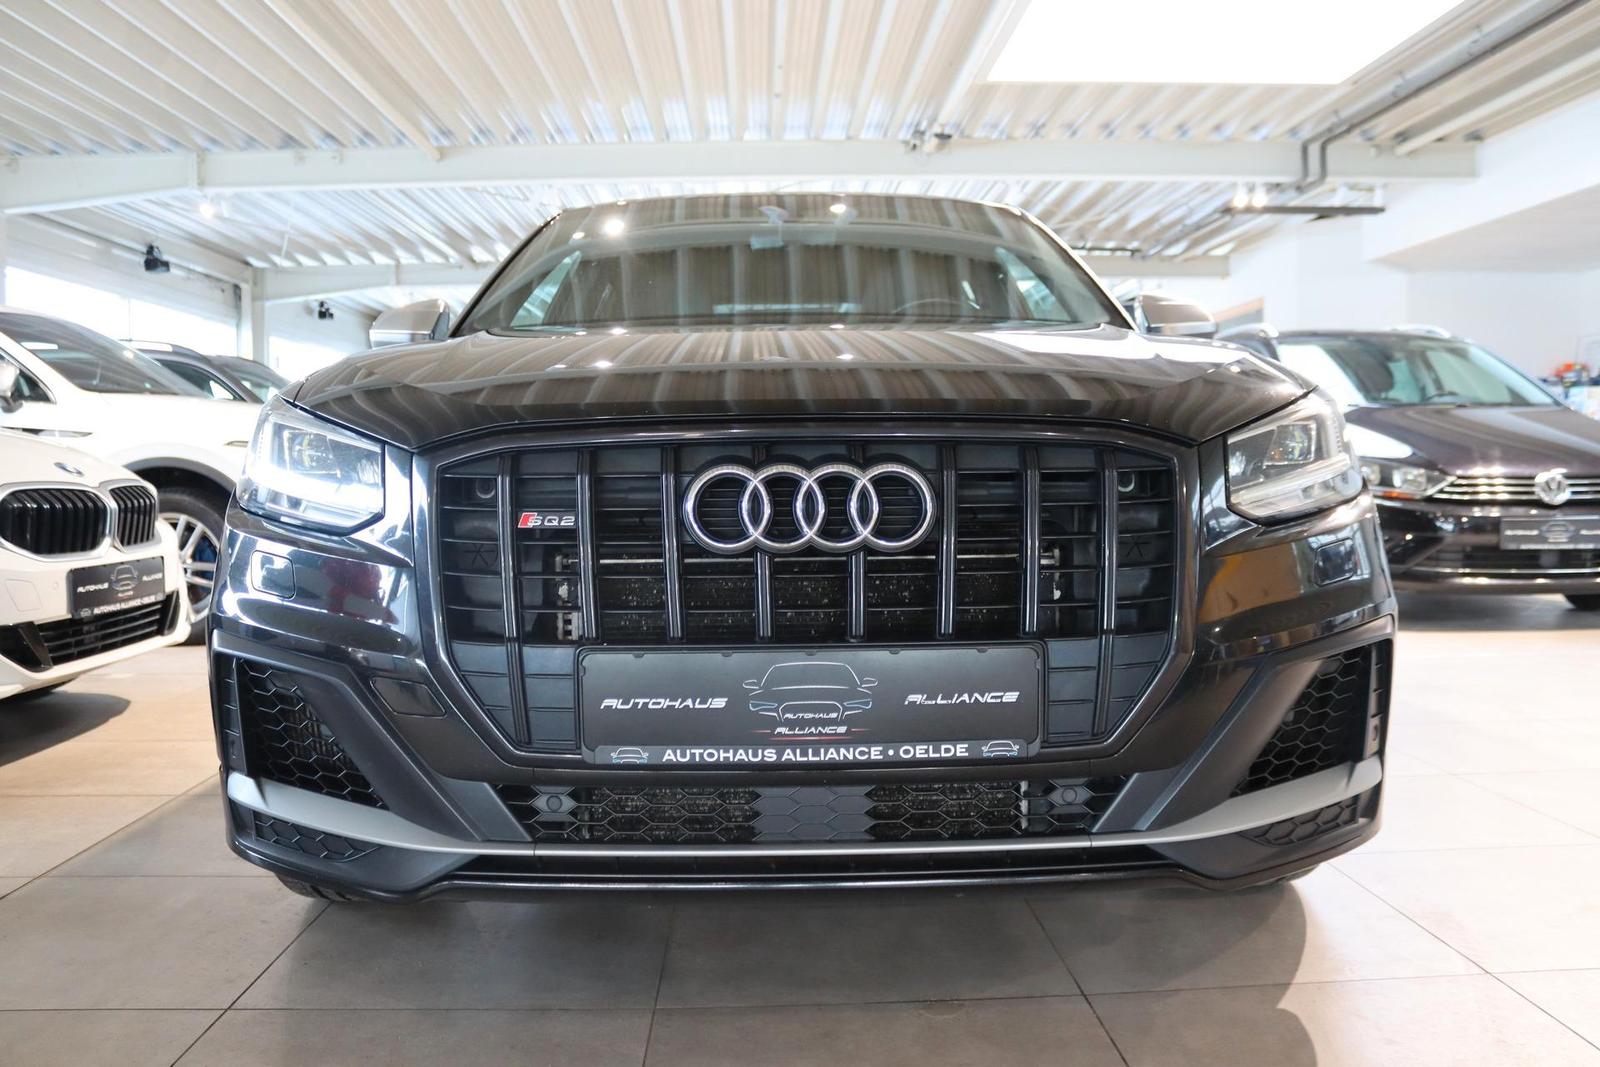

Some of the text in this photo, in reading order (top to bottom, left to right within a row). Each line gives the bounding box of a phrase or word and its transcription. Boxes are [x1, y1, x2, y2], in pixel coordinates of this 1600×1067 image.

[525, 514, 576, 527] SQ2
[600, 697, 728, 709] AUTOHAUS
[904, 691, 1020, 705] ALLIANCE
[774, 726, 848, 735] ALLIANCE
[662, 744, 969, 762] AUTOHAUS ALLIANCE OELDE
